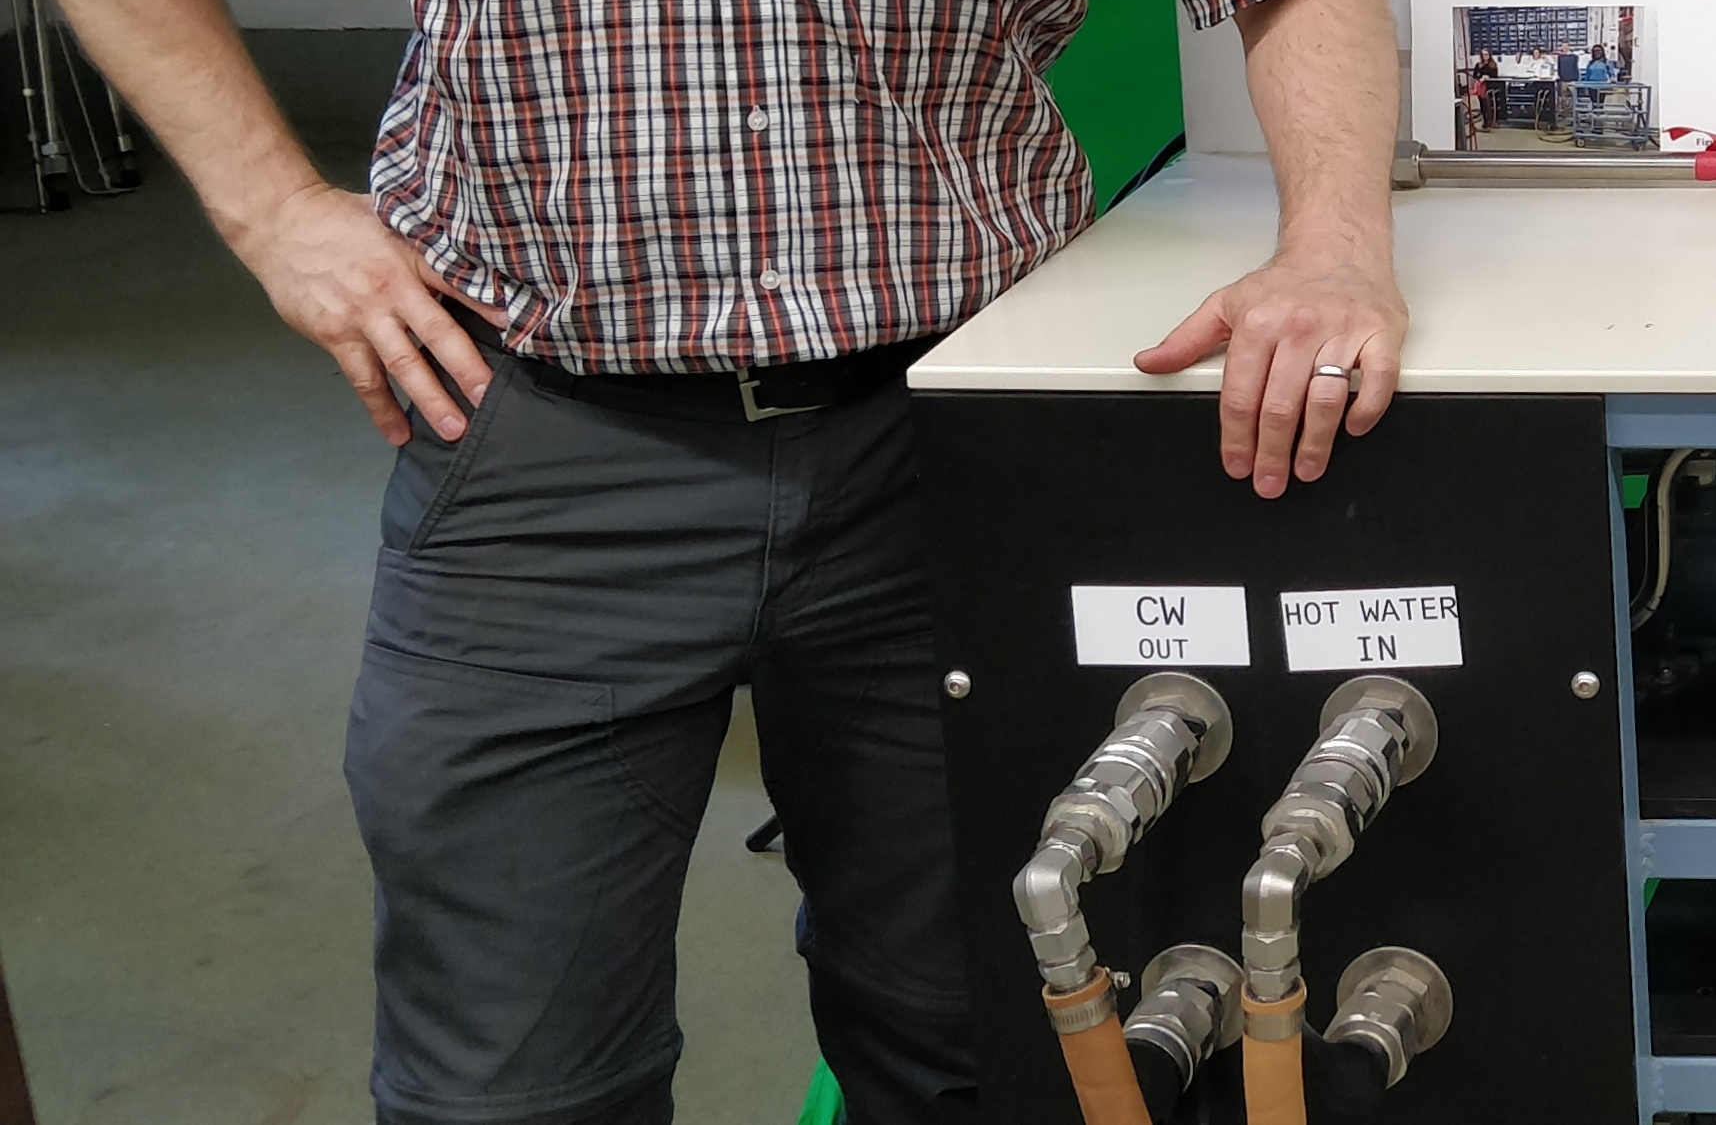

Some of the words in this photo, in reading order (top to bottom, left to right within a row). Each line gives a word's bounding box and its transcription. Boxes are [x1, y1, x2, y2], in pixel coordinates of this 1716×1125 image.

[1136, 596, 1185, 627] CW
[1285, 601, 1339, 626] HOT
[1360, 596, 1459, 624] WATER
[1138, 638, 1188, 660] OUT
[1358, 635, 1397, 662] IN
